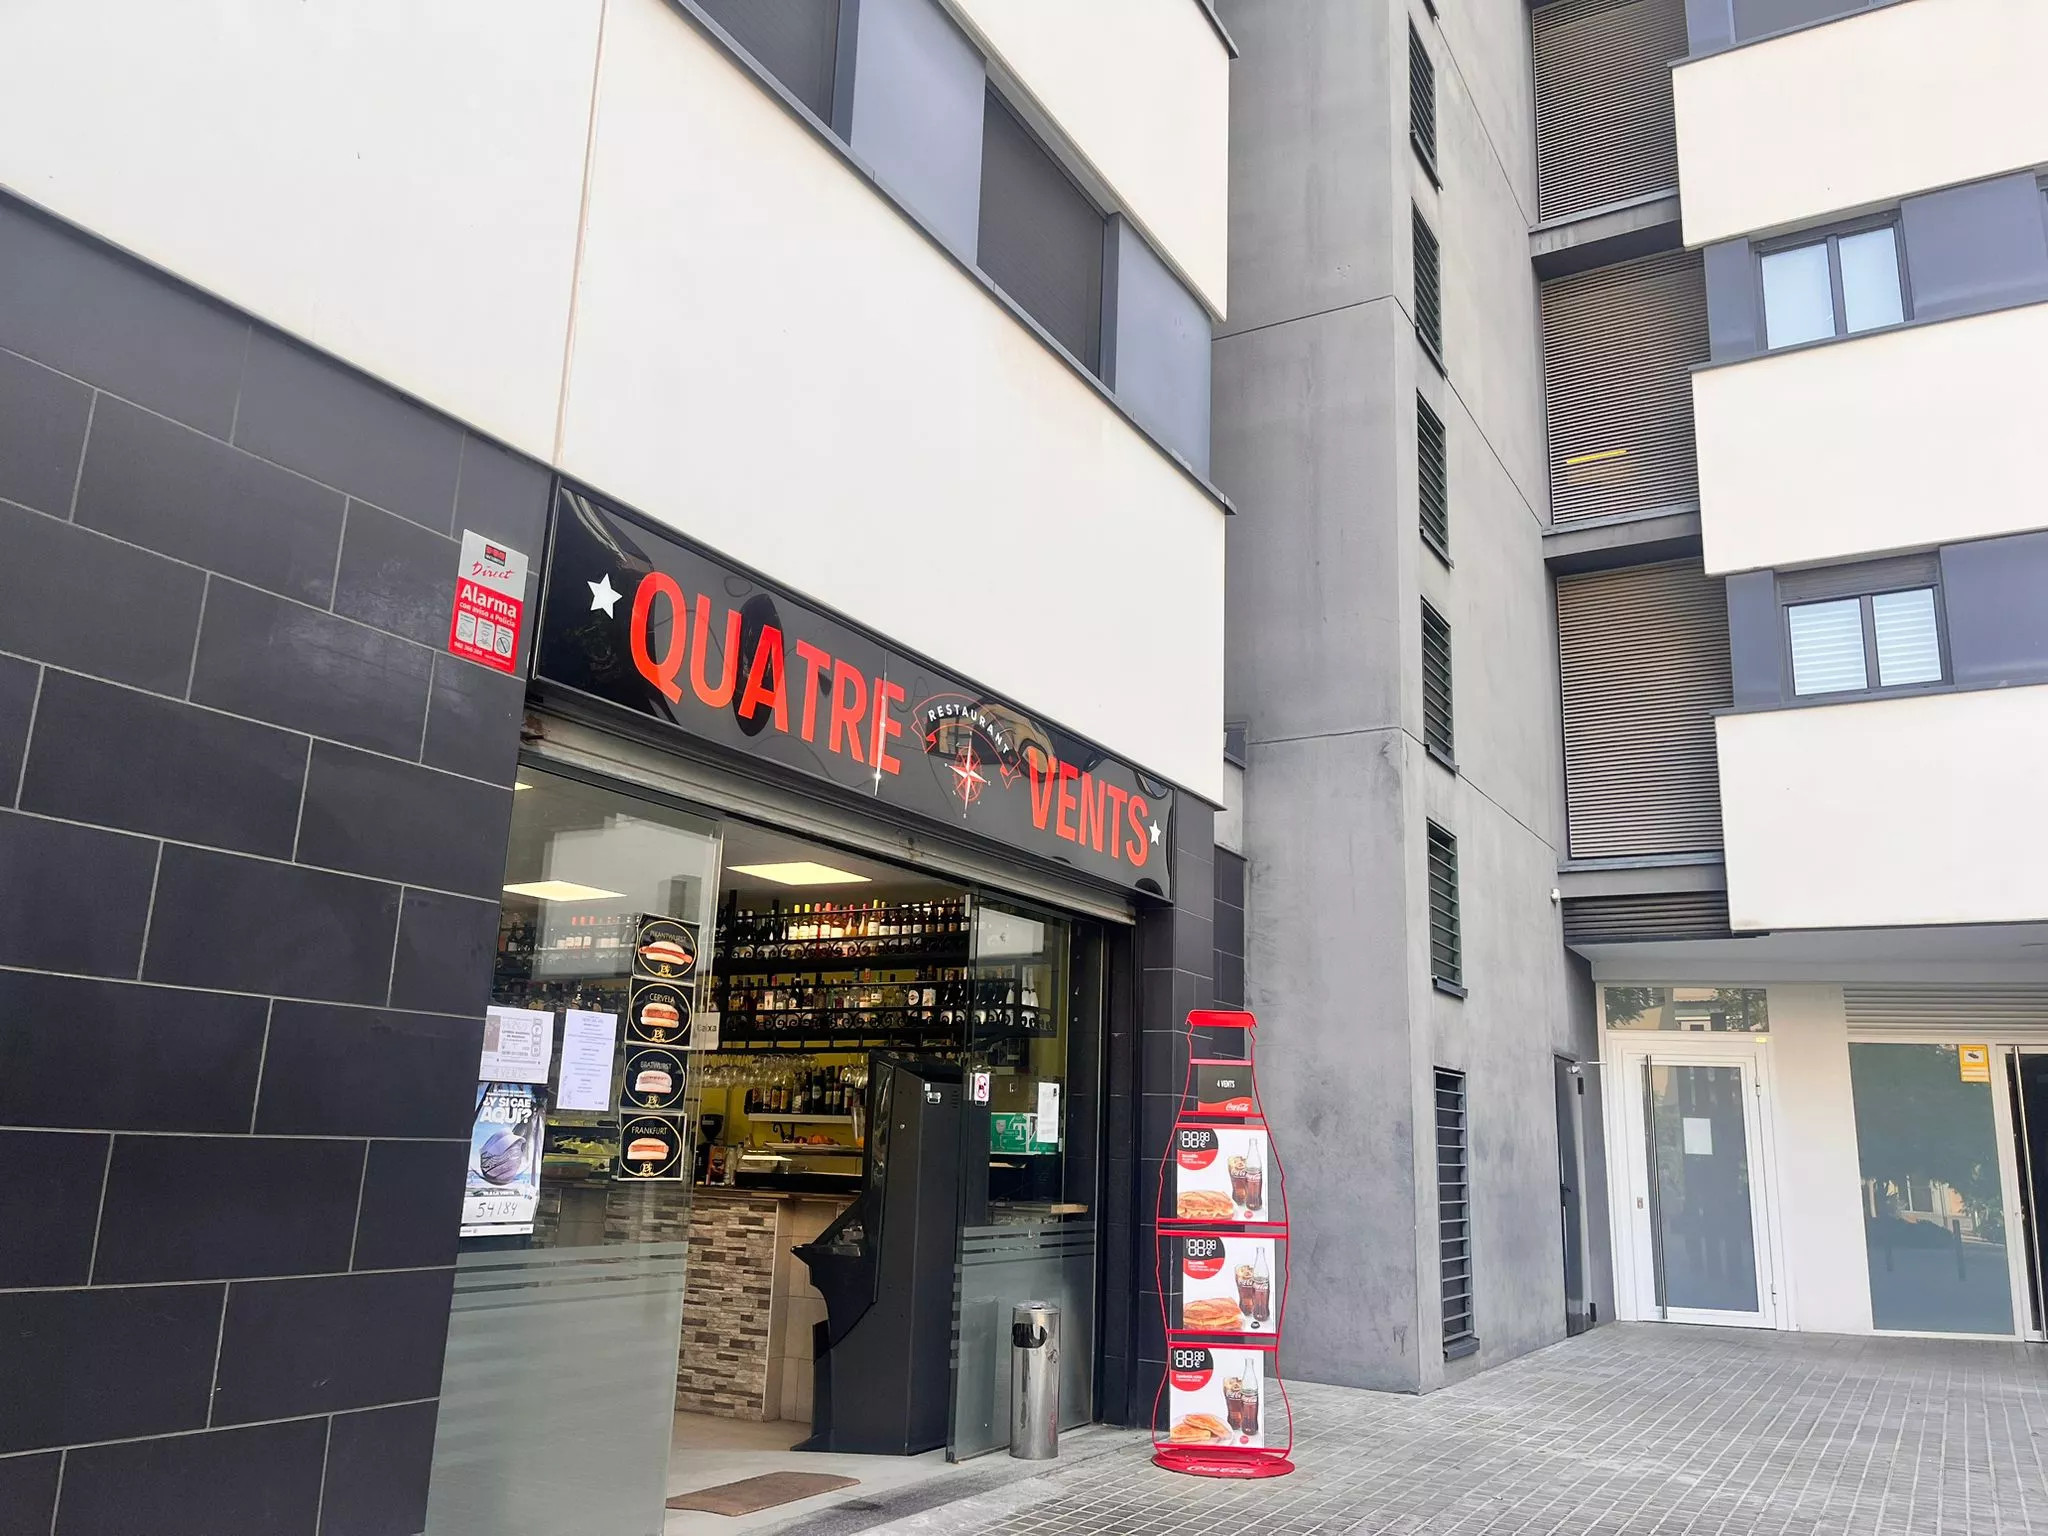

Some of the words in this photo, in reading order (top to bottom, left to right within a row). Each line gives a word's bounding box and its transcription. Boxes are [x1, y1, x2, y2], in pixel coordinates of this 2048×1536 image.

[472, 561, 514, 579] Direct
[459, 602, 471, 610] con
[461, 584, 517, 618] Alarma
[629, 571, 905, 775] QUATRE
[1027, 745, 1149, 867] VENTS
[928, 704, 1010, 754] RESTAURANT
[499, 1097, 510, 1107] SI
[510, 1098, 531, 1108] CAE
[632, 1126, 667, 1135] FRANKFURT
[476, 1202, 518, 1218] 54184
